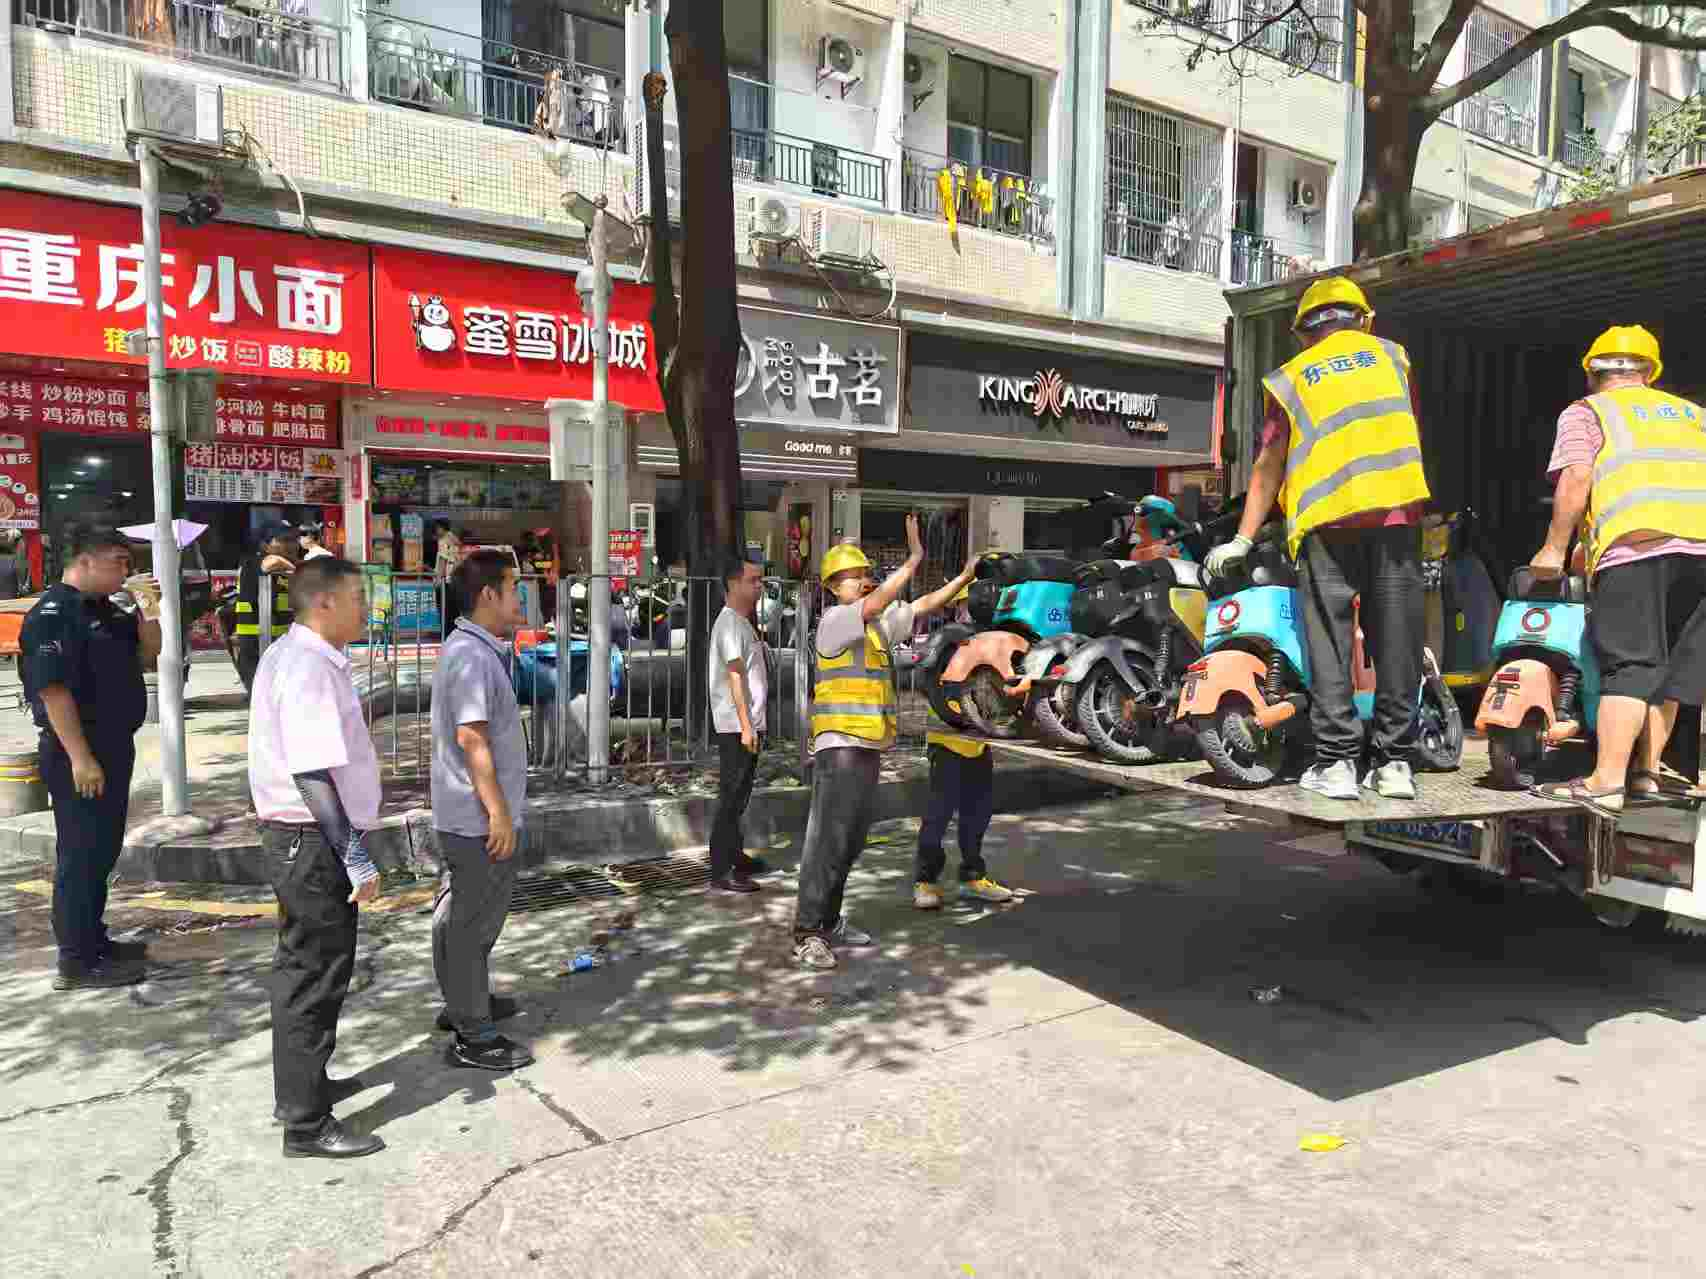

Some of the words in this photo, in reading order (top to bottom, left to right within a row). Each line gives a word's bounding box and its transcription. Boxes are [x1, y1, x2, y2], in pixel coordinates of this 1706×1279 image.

[0, 227, 346, 336] 重庆小面
[267, 344, 352, 374] 酸辣粉
[463, 306, 647, 370] 蜜雪冰城
[799, 341, 887, 406] 古茗
[979, 375, 1034, 404] KING
[1062, 386, 1121, 413] ARCH
[272, 402, 326, 420] 牛肉面
